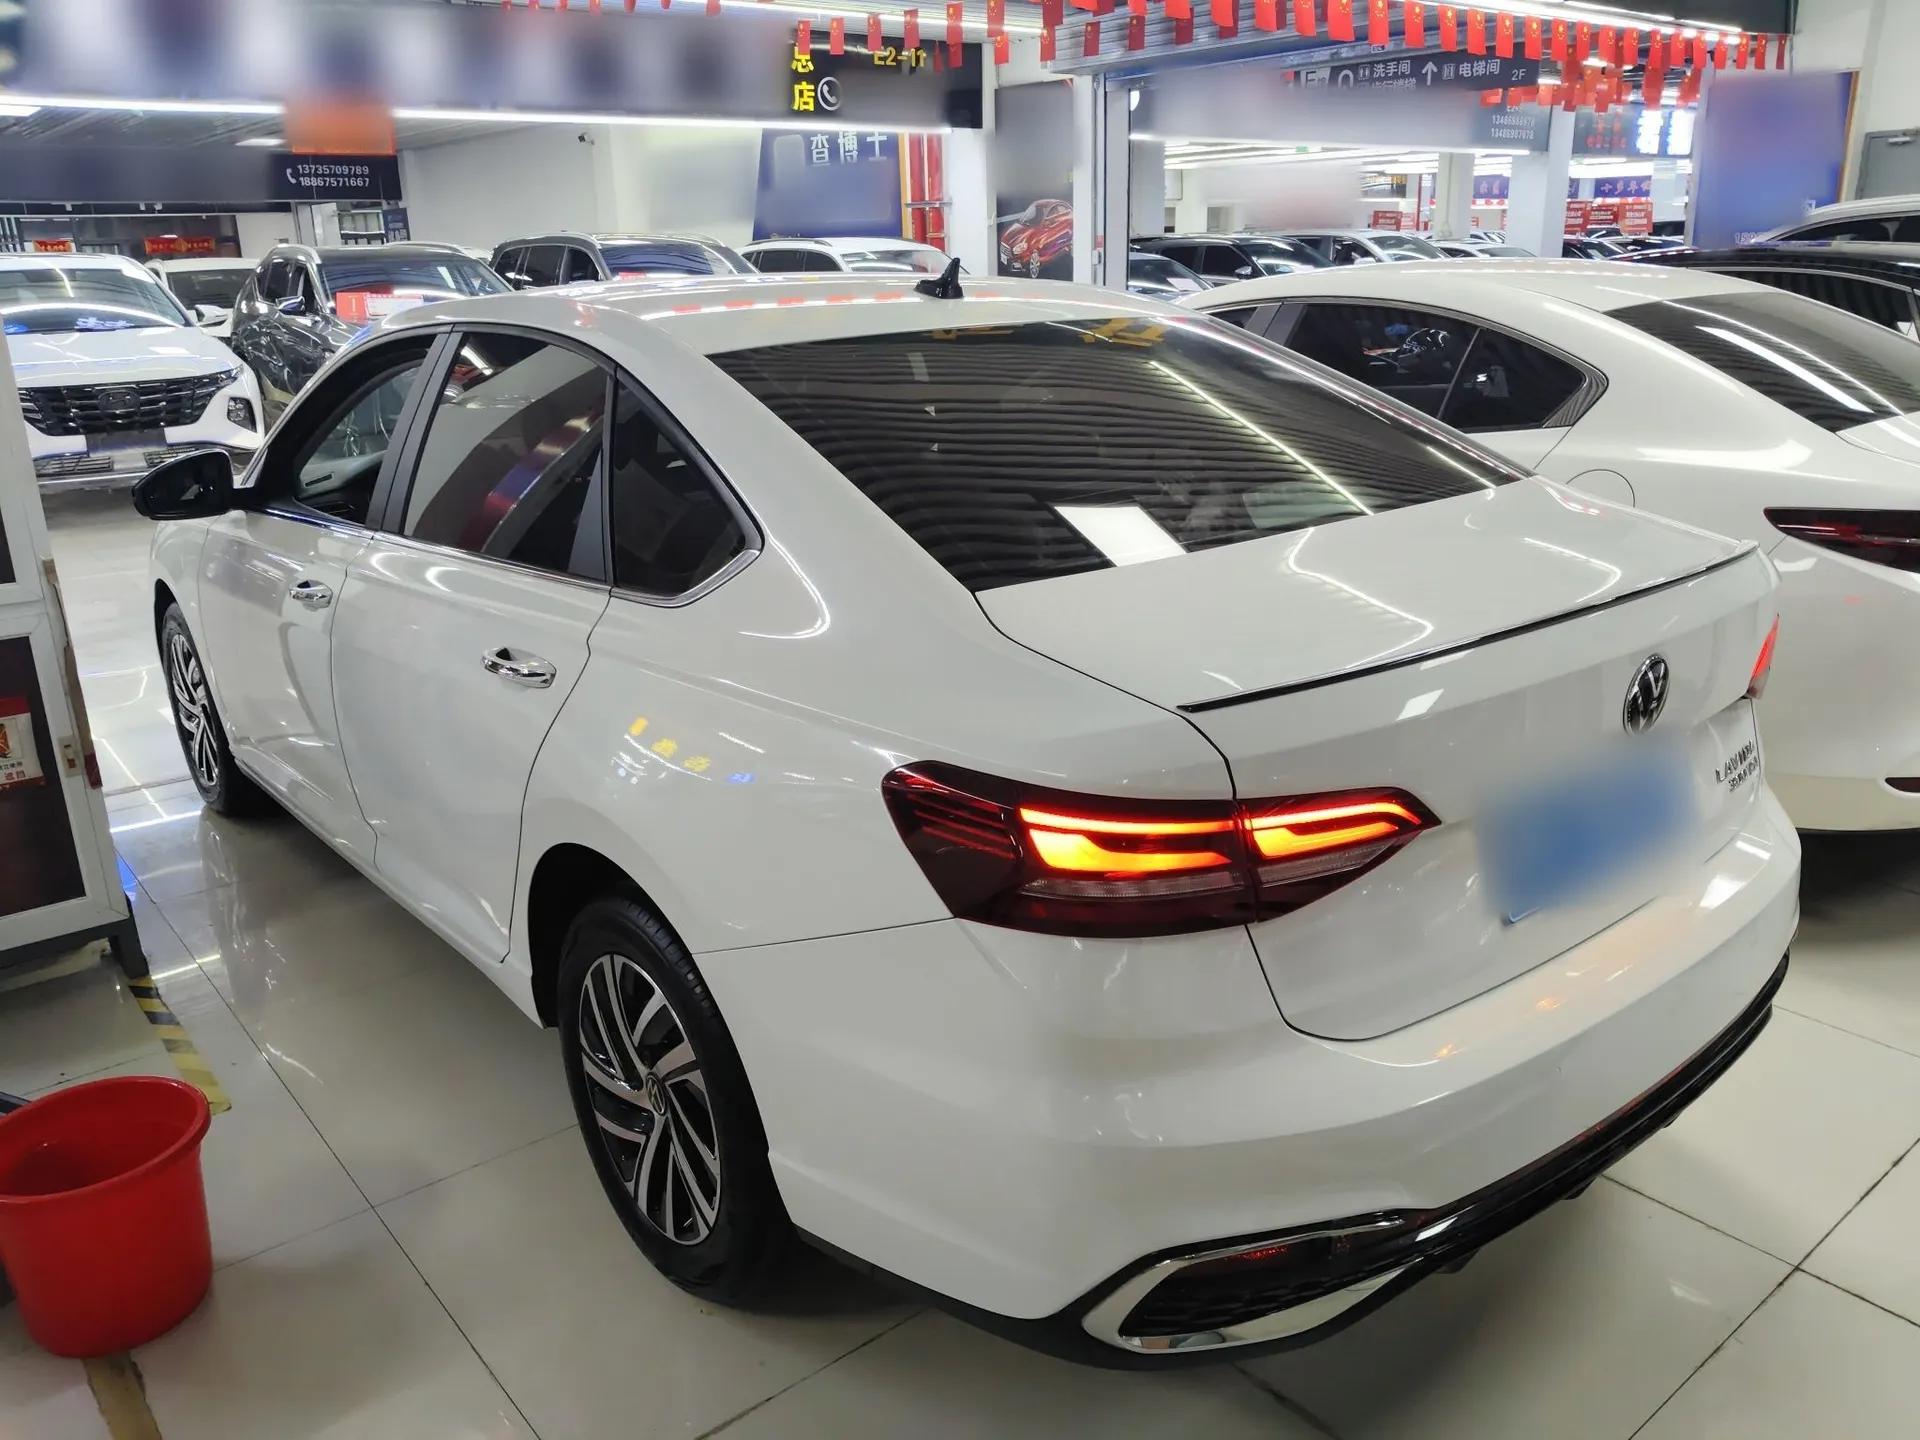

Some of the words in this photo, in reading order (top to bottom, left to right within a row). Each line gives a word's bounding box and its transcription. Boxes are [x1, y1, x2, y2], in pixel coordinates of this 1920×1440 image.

[1373, 60, 1411, 78] 洗手间
[1459, 59, 1501, 77] 电梯间
[1511, 69, 1526, 81] 2F
[810, 131, 888, 167] 查博士
[297, 164, 369, 175] 13735709789
[299, 177, 369, 187] 18867571667
